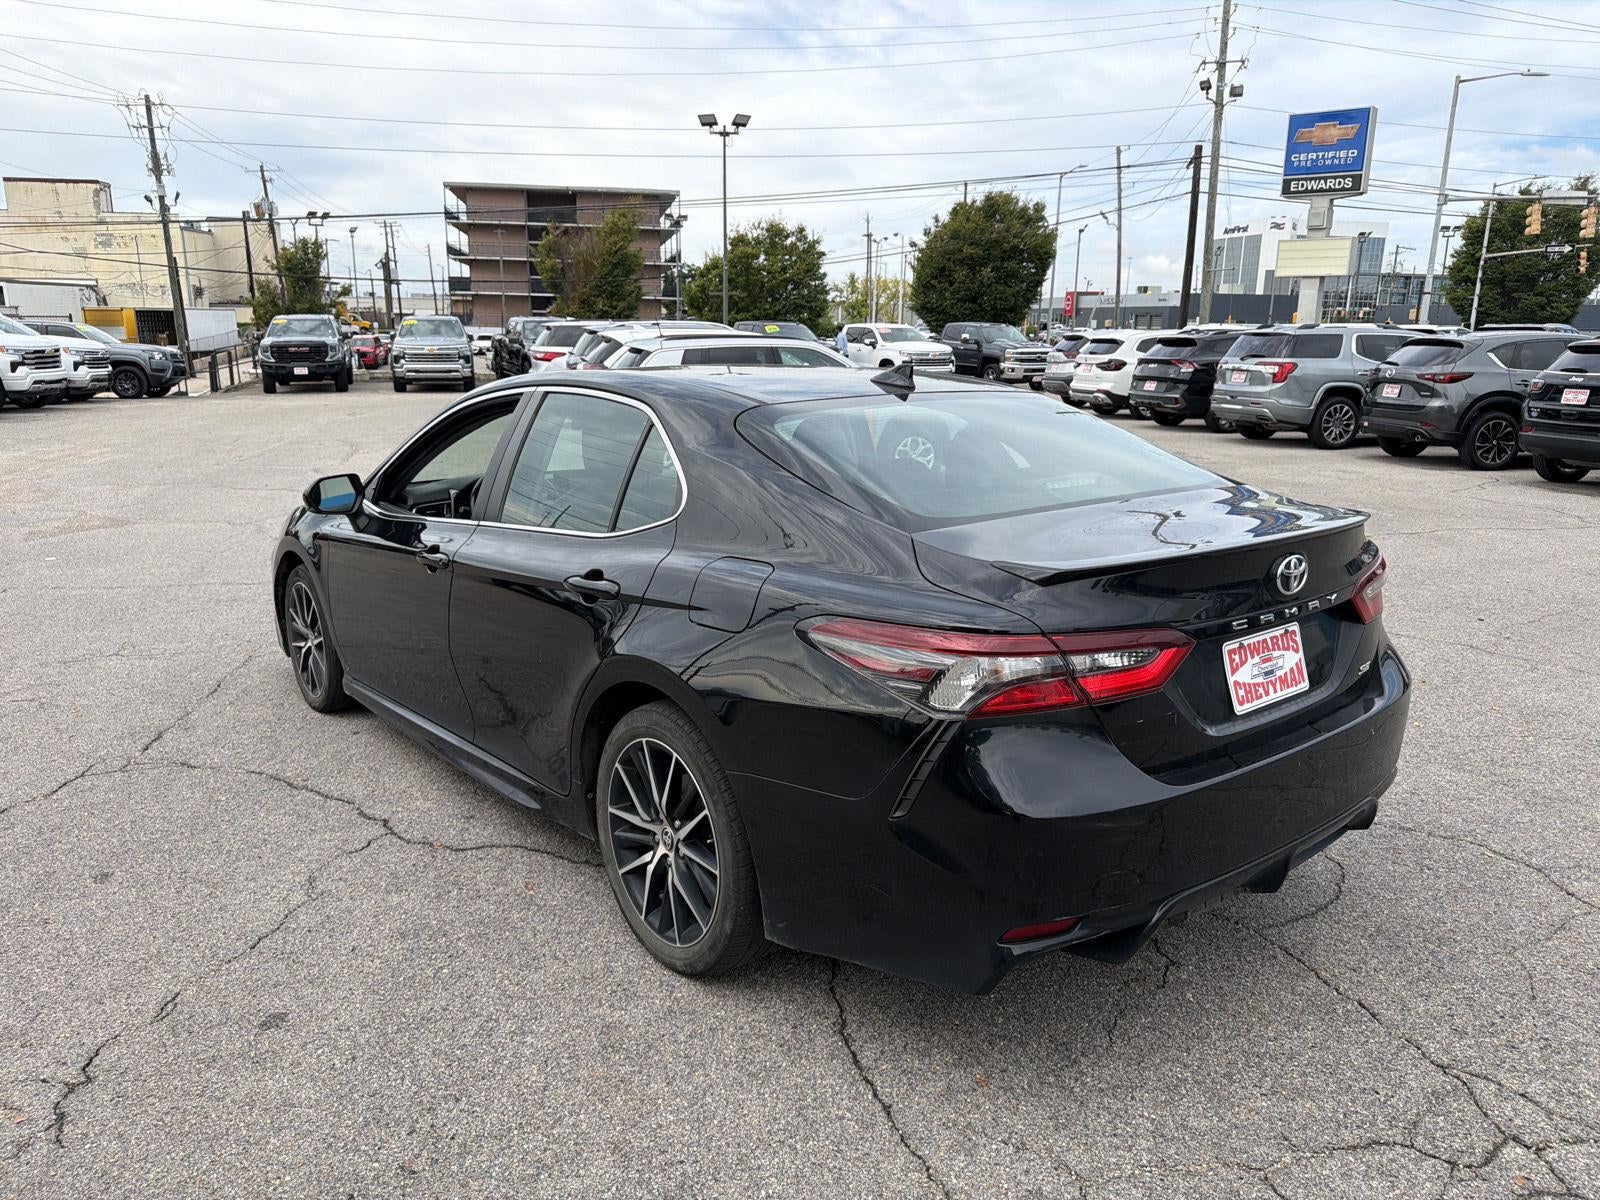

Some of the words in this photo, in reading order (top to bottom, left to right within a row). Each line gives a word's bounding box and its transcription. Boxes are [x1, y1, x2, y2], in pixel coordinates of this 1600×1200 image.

[1291, 149, 1358, 162] CERTIFIED
[1293, 157, 1353, 167] PRE-OWNED
[1290, 177, 1353, 191] EDWARDS
[1223, 224, 1249, 235] AmFirst
[1097, 297, 1124, 305] NISSN
[1232, 593, 1337, 630] CAMRY
[1227, 629, 1300, 678] EDWARDS
[1358, 660, 1371, 675] SE
[1233, 657, 1306, 706] CHEVYMAN
